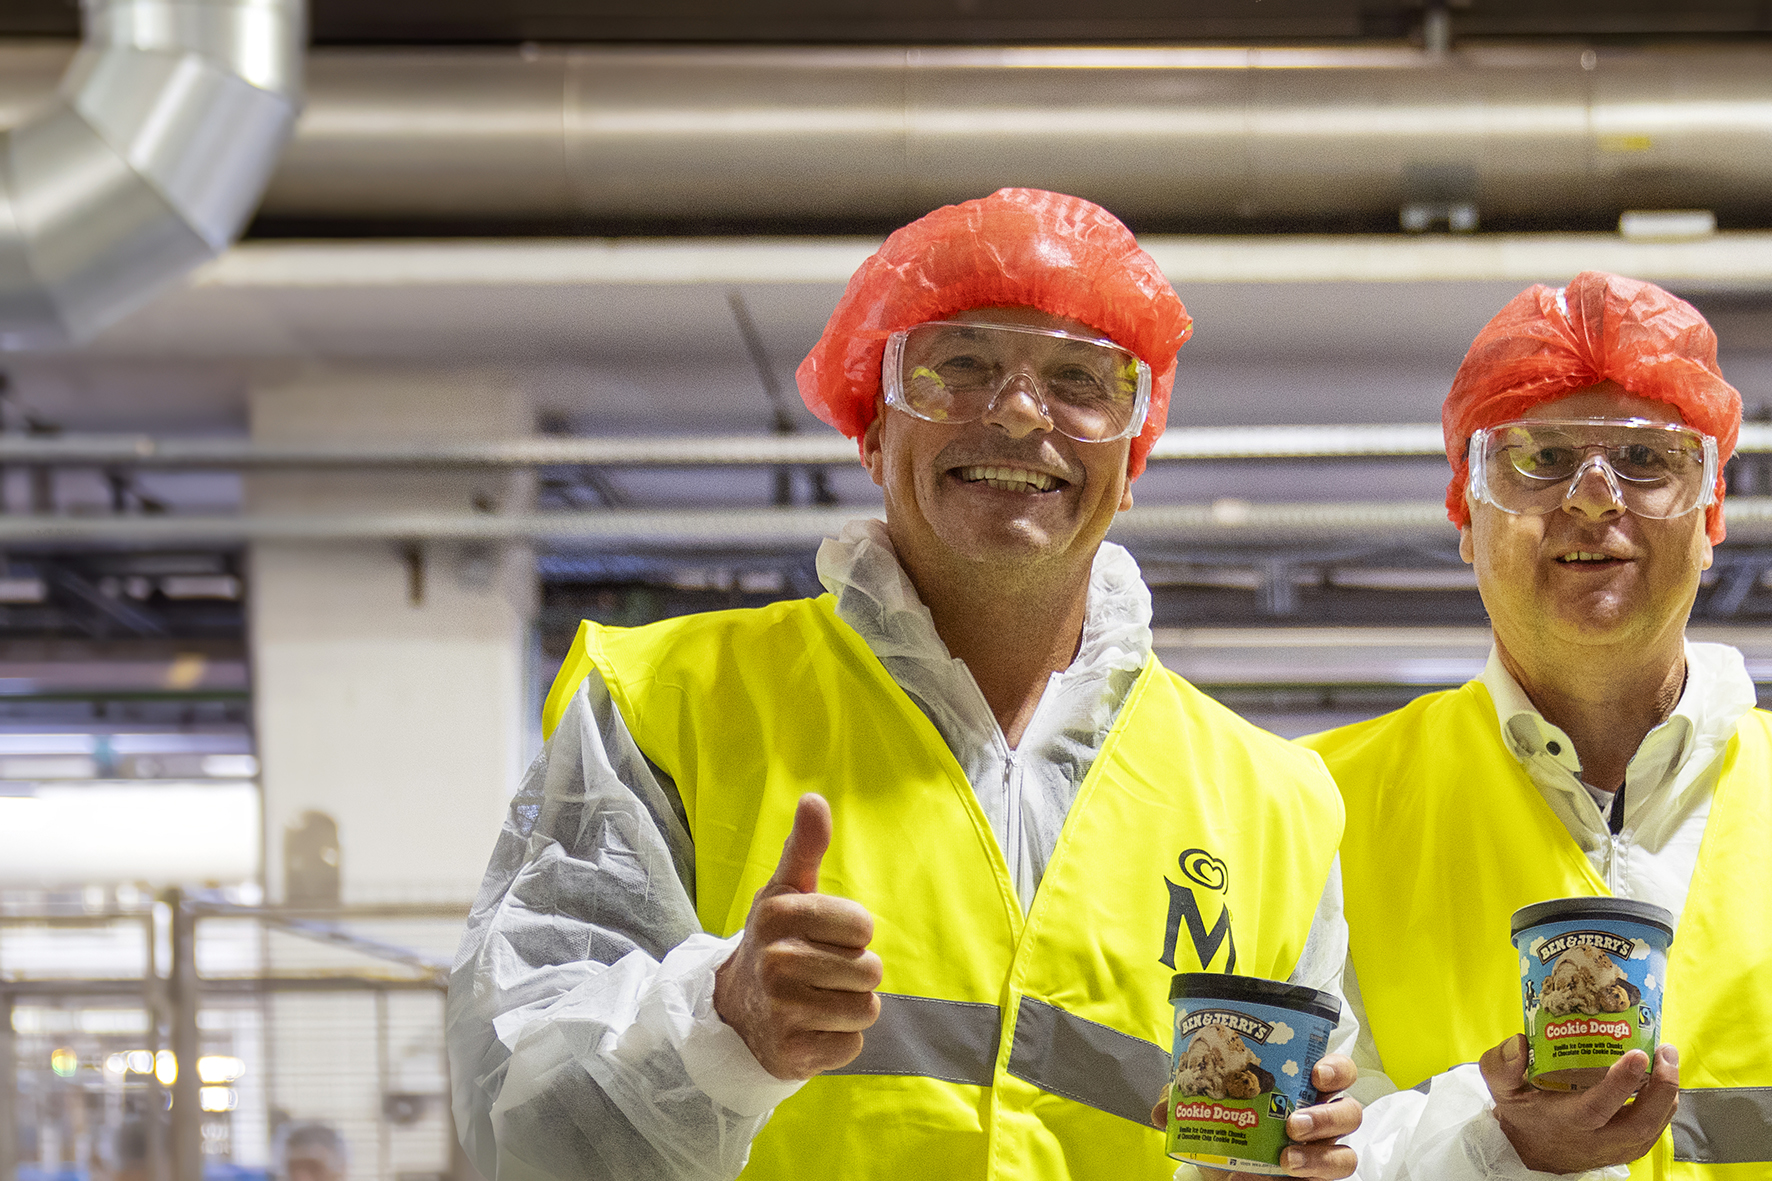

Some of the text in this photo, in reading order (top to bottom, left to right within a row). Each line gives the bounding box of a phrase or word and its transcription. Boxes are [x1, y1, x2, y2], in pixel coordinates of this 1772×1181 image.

[1546, 1021, 1630, 1038] Cookie Dough
[1176, 1105, 1256, 1127] Cookie Dough
